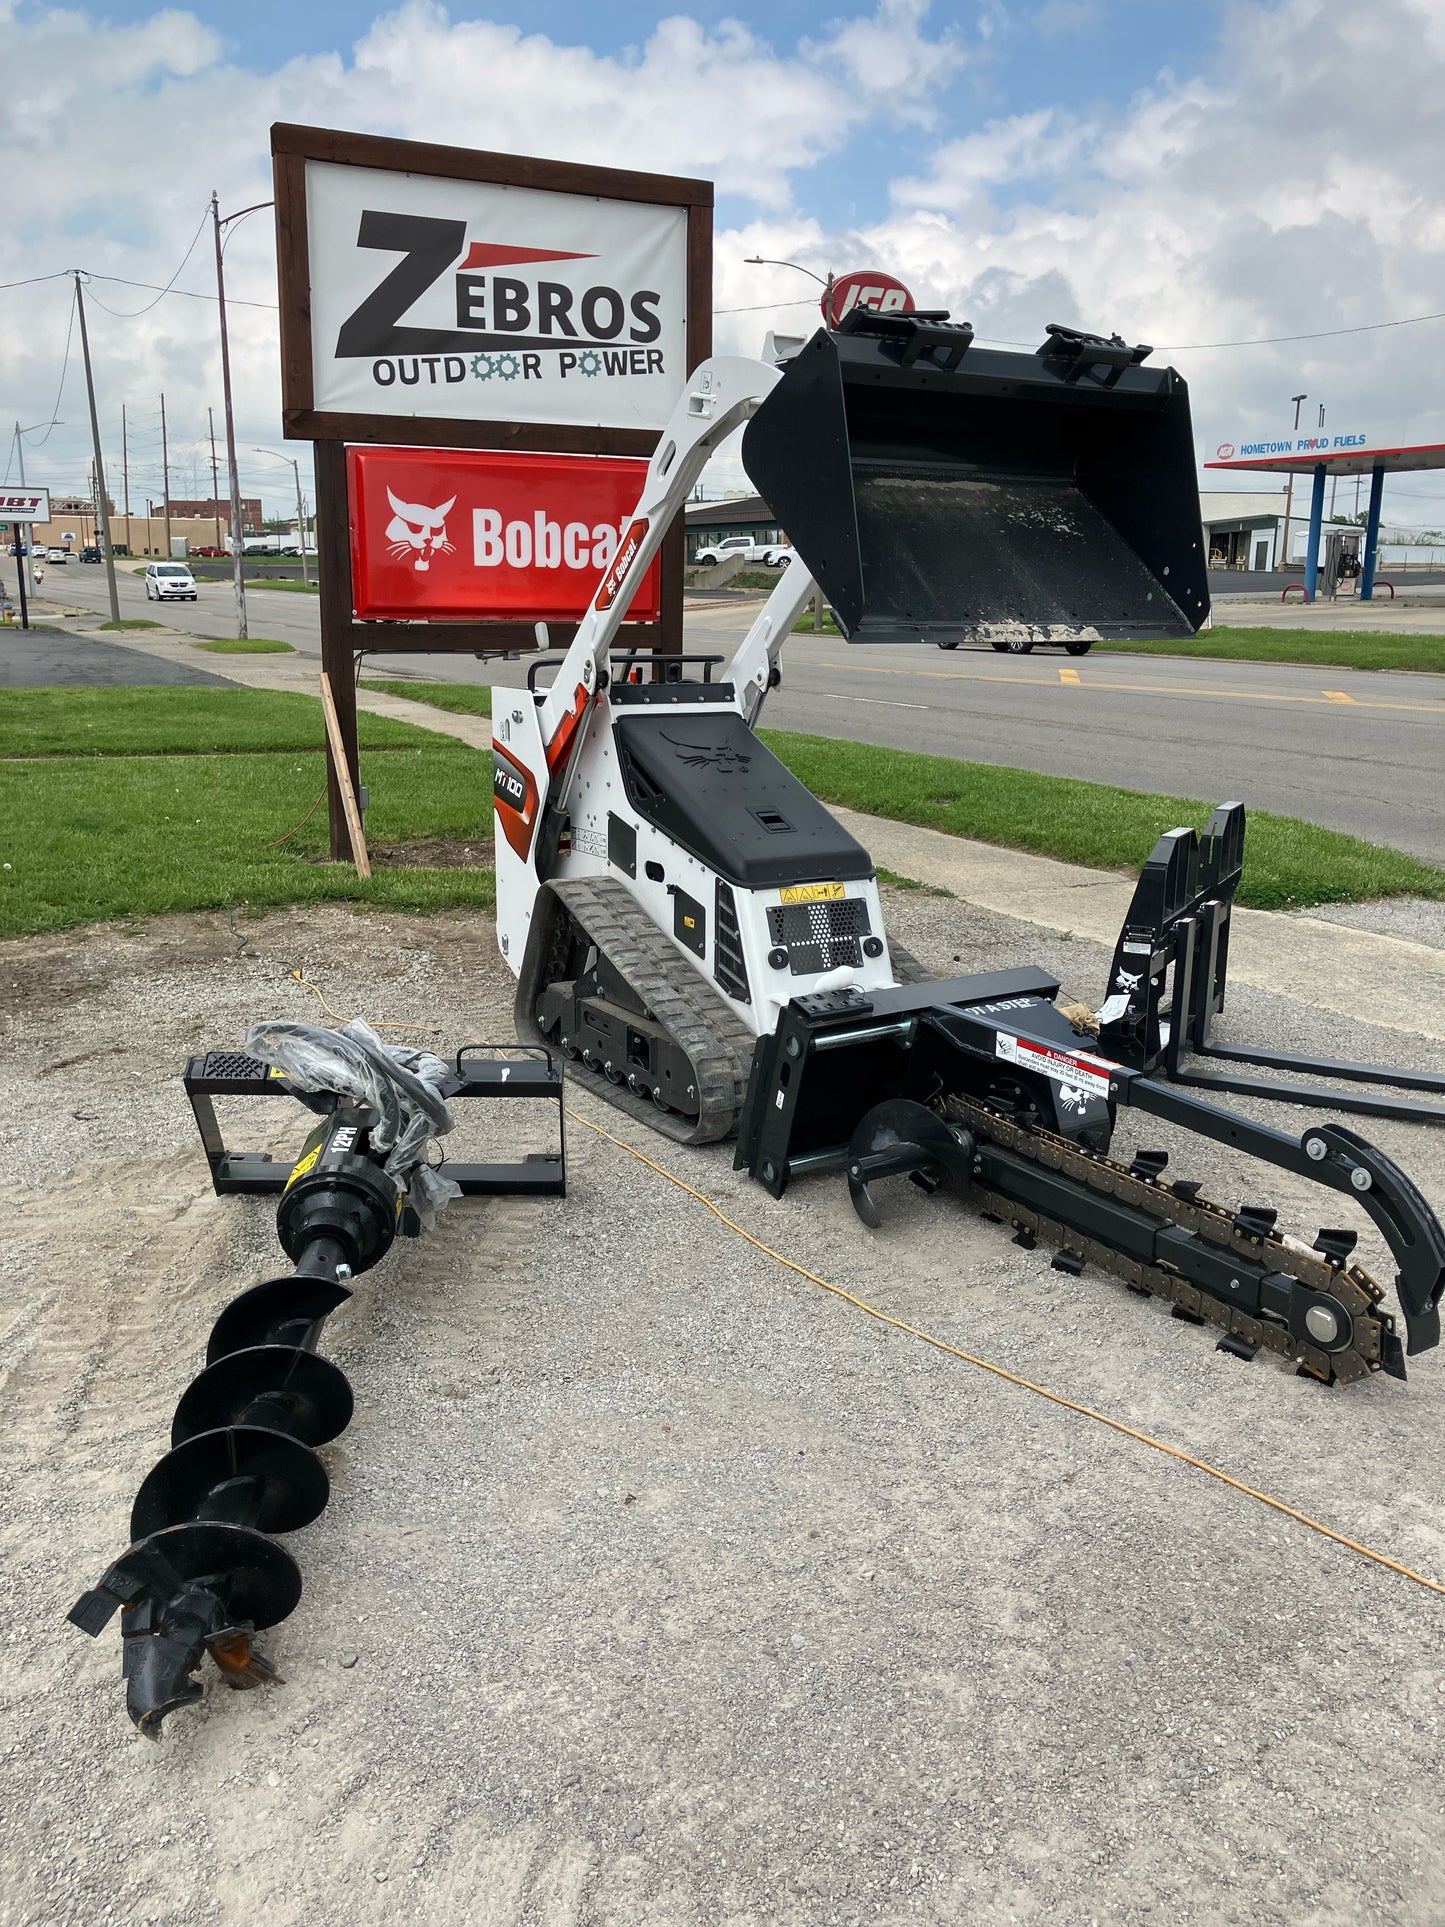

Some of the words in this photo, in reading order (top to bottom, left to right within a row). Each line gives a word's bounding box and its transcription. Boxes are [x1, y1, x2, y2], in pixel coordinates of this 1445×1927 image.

[335, 209, 661, 358] ZEBROS
[372, 353, 542, 386] OUTDOOR
[559, 349, 665, 378] POWER
[1219, 446, 1232, 457] IGA
[1240, 441, 1292, 455] HOMETOWN
[1297, 437, 1329, 450] PRUD
[1334, 434, 1366, 447] FUELS
[615, 538, 637, 582] Bobcat
[996, 998, 1038, 1010] STEP
[1031, 1053, 1047, 1063] AVOID
[1047, 1058, 1066, 1070] INJURY
[1066, 1065, 1074, 1074] OR
[1075, 1069, 1093, 1080] DEATH
[1053, 1053, 1078, 1067] DANGER
[331, 1127, 358, 1153] 12PH
